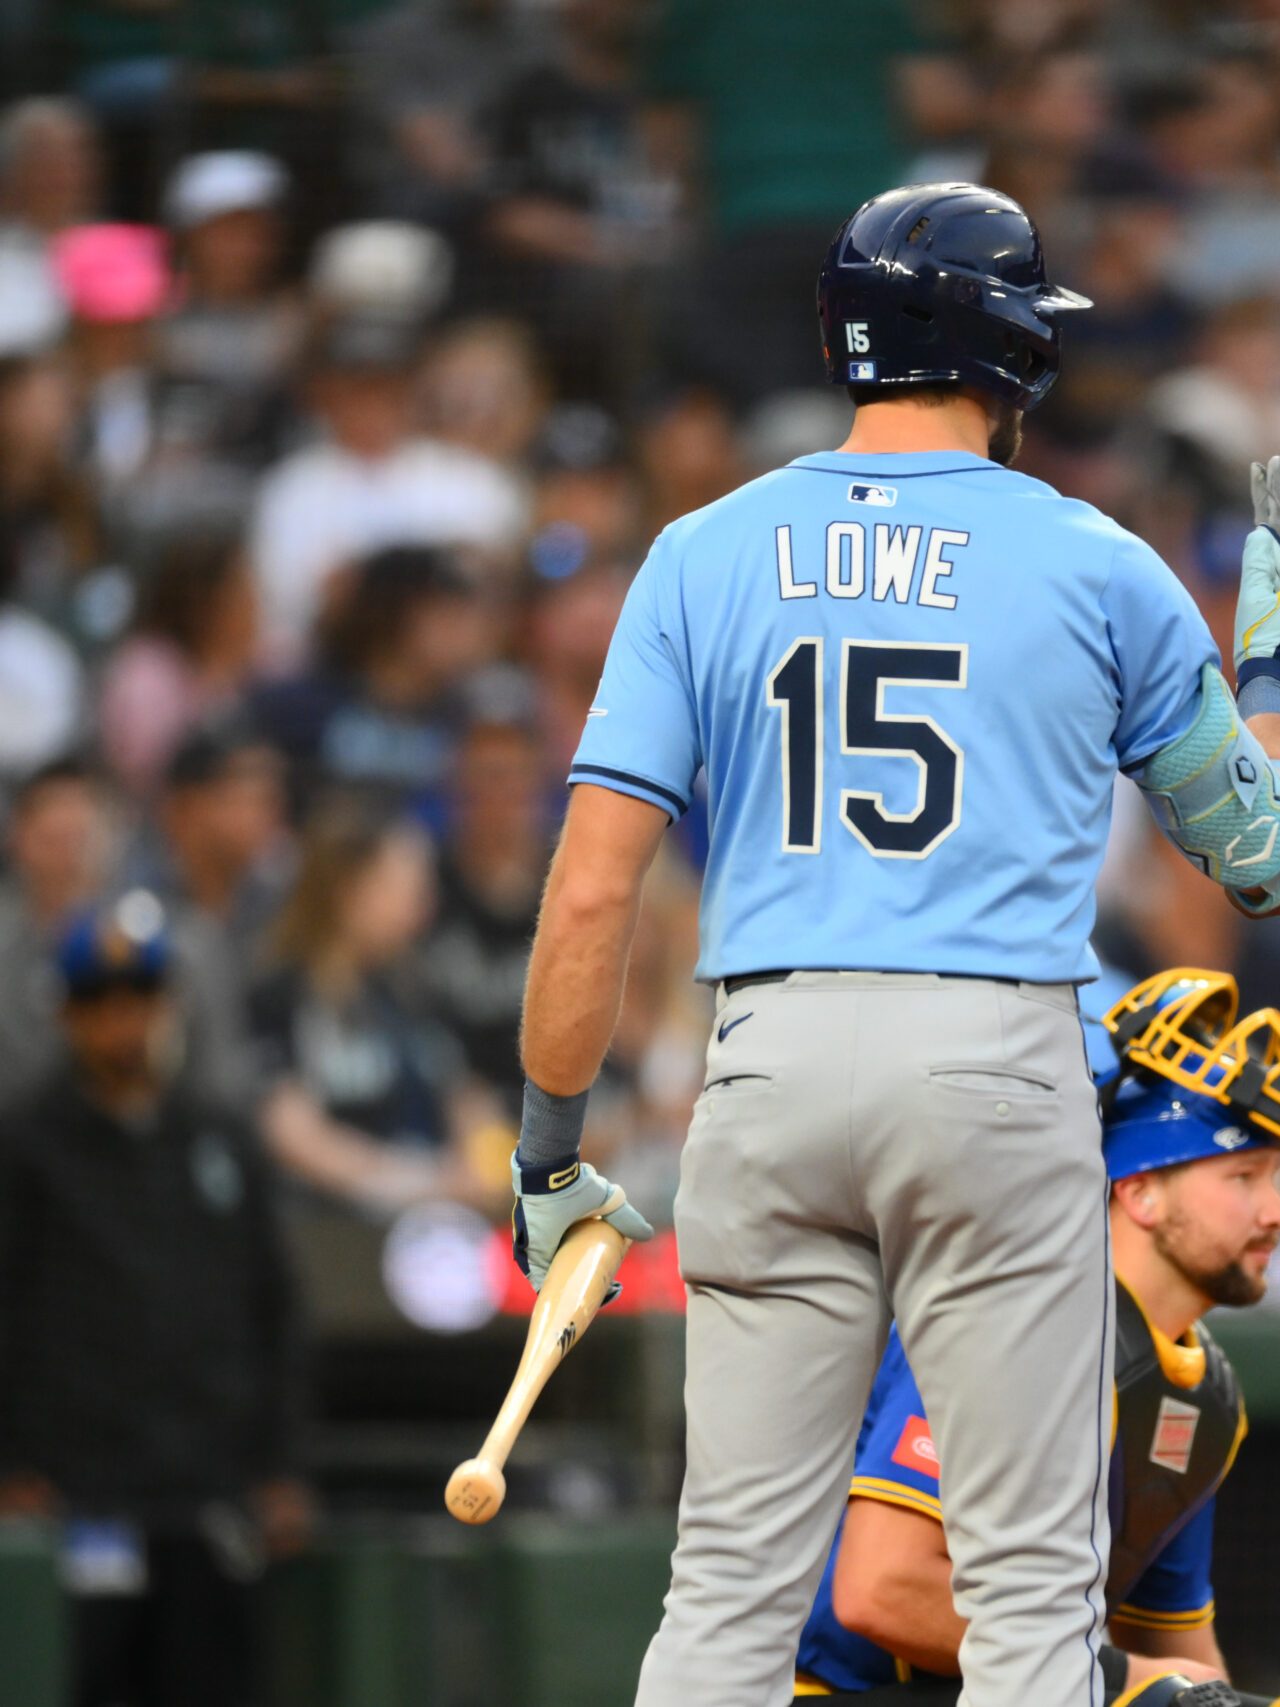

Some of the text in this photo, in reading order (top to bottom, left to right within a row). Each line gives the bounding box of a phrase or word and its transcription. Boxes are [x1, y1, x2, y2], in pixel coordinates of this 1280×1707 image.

[845, 322, 870, 353] 15
[775, 520, 970, 610] LOWE
[766, 636, 968, 860] 15
